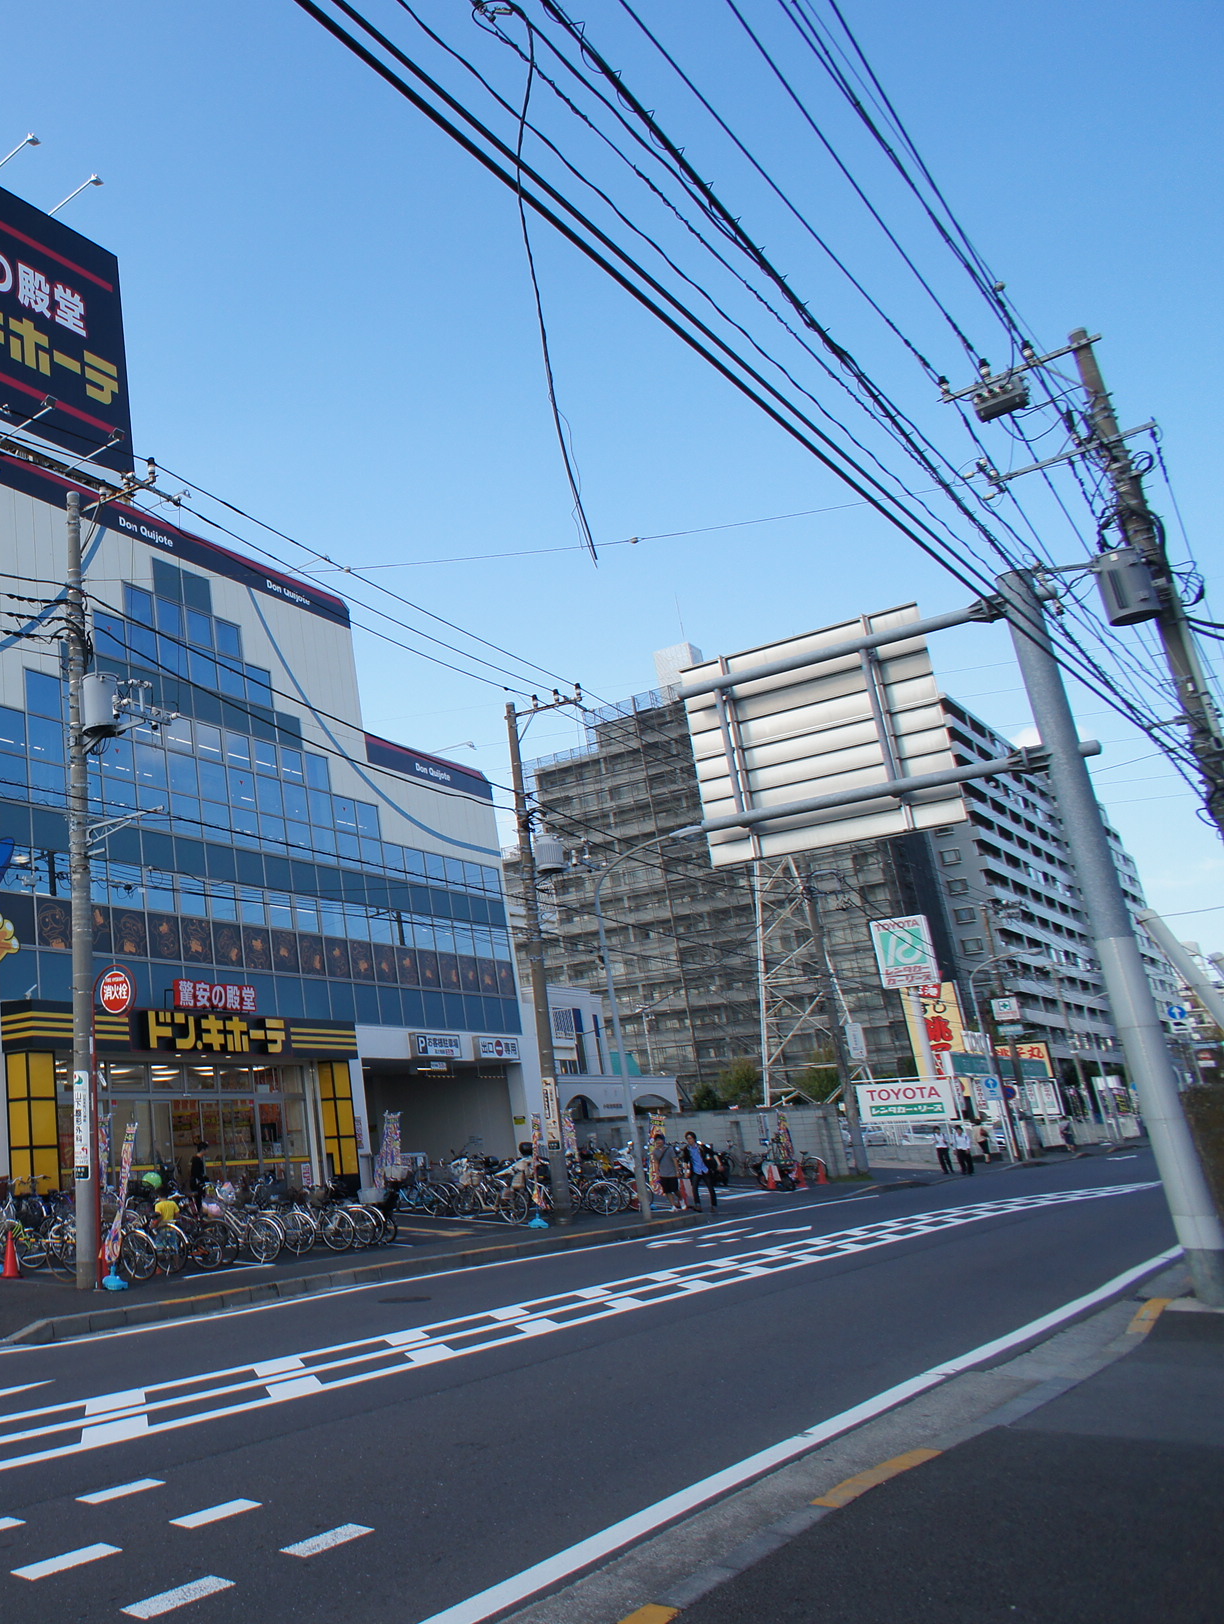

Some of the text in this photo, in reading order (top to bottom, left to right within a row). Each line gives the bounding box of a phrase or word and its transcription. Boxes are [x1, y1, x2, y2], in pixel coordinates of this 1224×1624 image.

[118, 515, 174, 547] Don Quijote
[265, 579, 311, 606] Don Quijote
[415, 762, 451, 782] Don Quijote
[874, 919, 920, 931] TOYOTA
[885, 965, 930, 975] レンタカー
[103, 983, 128, 1001] 消火栓
[178, 980, 256, 1011] 驚安の殿堂
[418, 1036, 426, 1053] P
[481, 1041, 518, 1055] 出口 専用
[866, 1086, 941, 1101] TOYOTA
